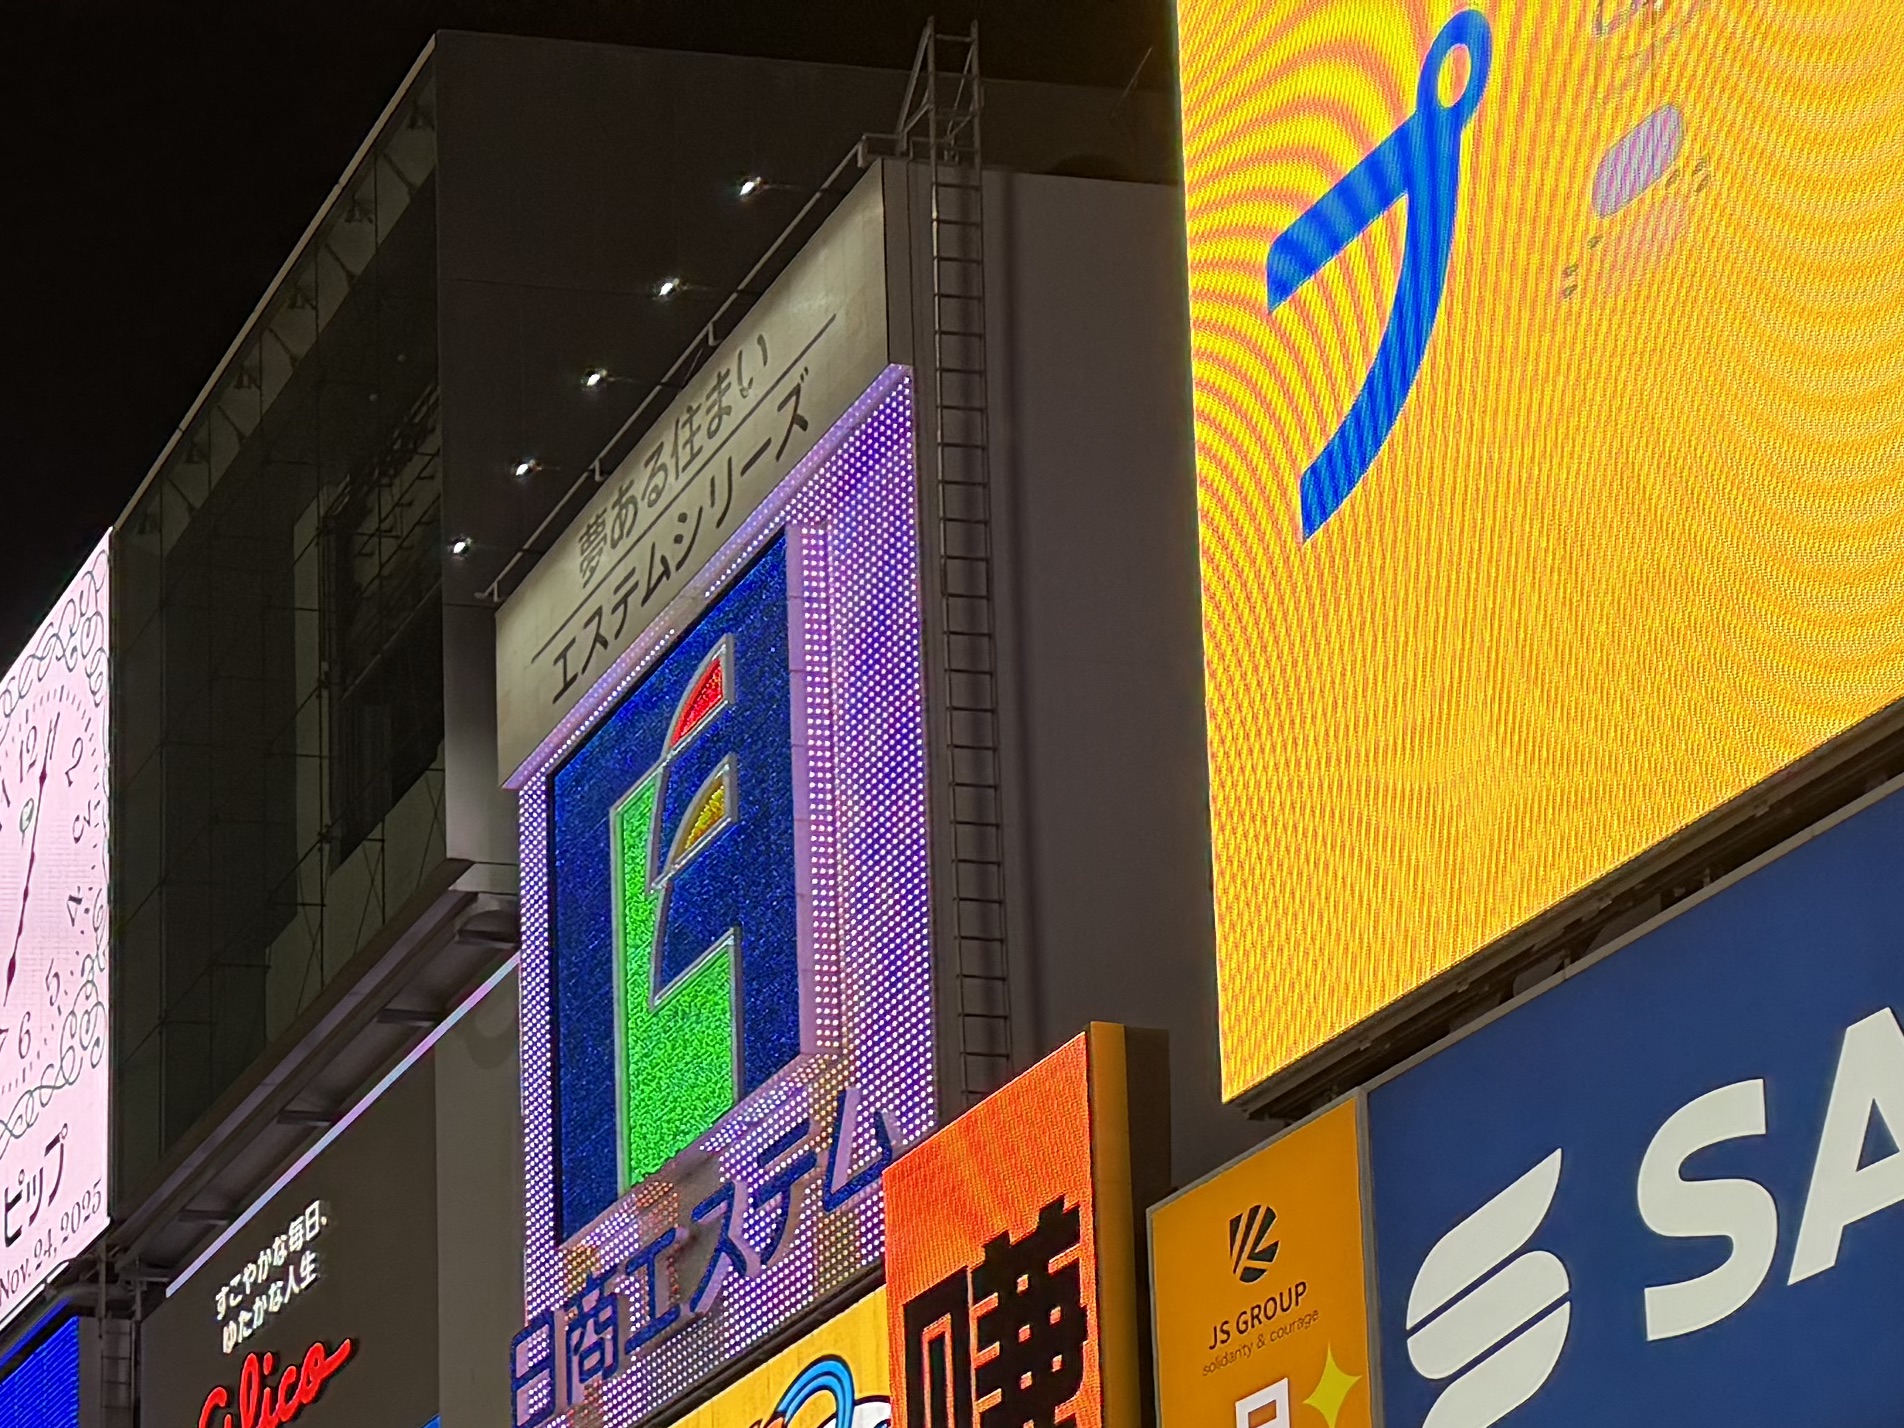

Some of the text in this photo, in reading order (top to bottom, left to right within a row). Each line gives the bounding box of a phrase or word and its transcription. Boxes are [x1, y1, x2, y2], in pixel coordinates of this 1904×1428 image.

[2, 1120, 69, 1250] ピップ
[34, 1225, 64, 1283] 24,
[63, 1180, 104, 1246] 2025
[1208, 1280, 1308, 1351] JS GROUP
[1269, 1309, 1320, 1343] courage
